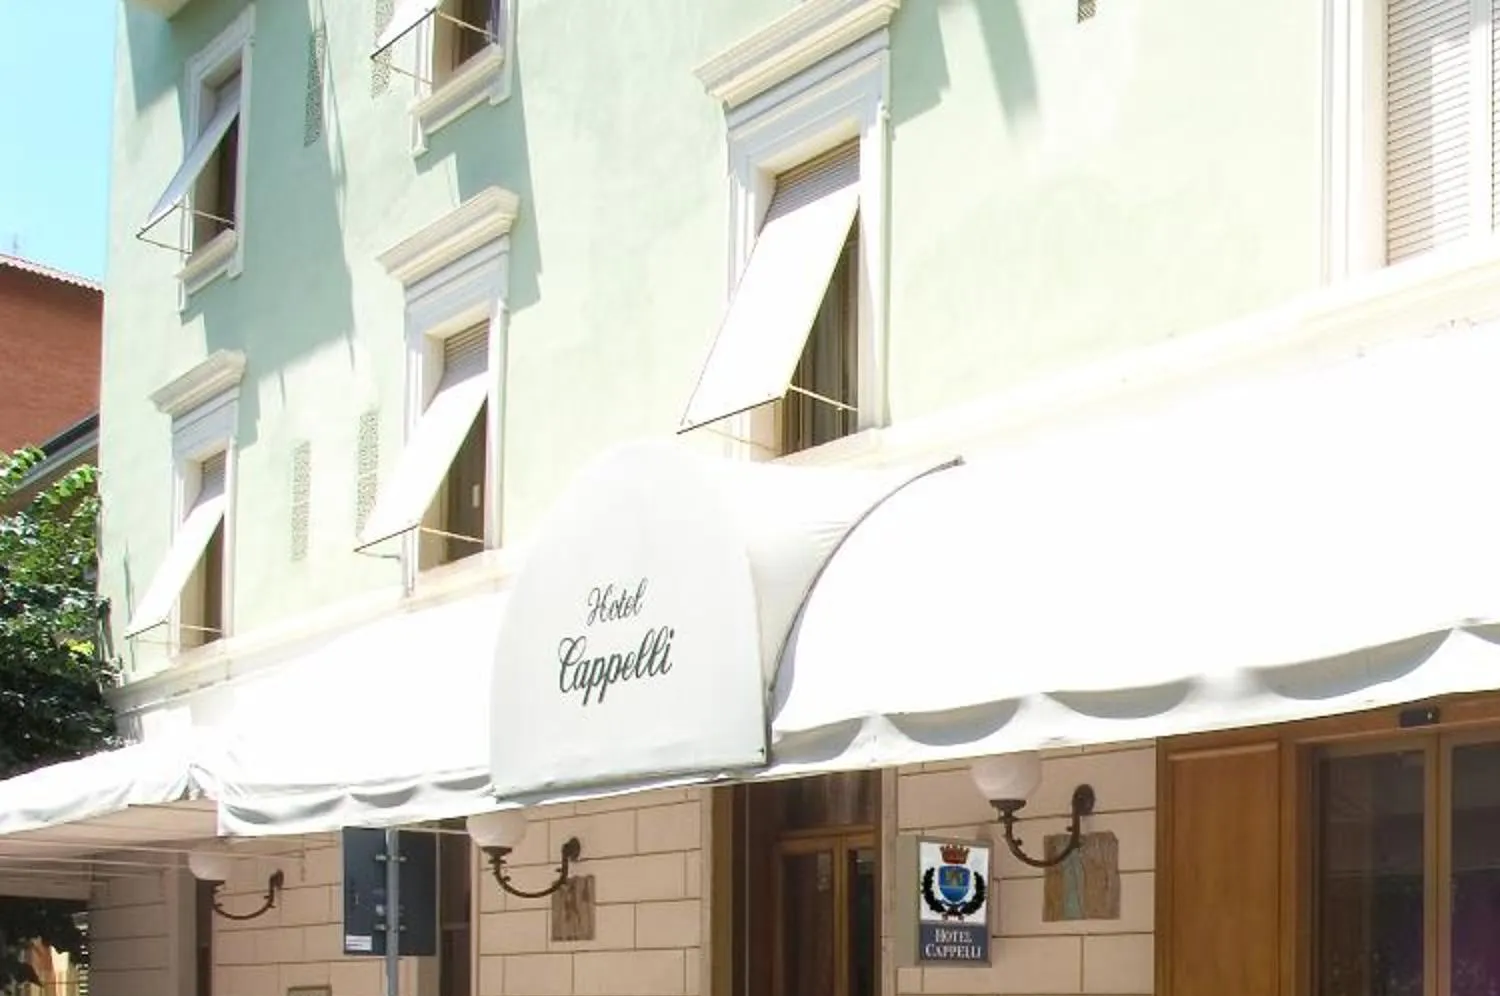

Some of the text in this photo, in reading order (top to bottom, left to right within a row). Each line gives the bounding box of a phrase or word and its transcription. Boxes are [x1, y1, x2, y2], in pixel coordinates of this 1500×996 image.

[586, 576, 649, 626] Hotel
[558, 625, 675, 706] Cappelli
[924, 943, 981, 959] CAPPELLI
[934, 927, 973, 943] HOTEL
